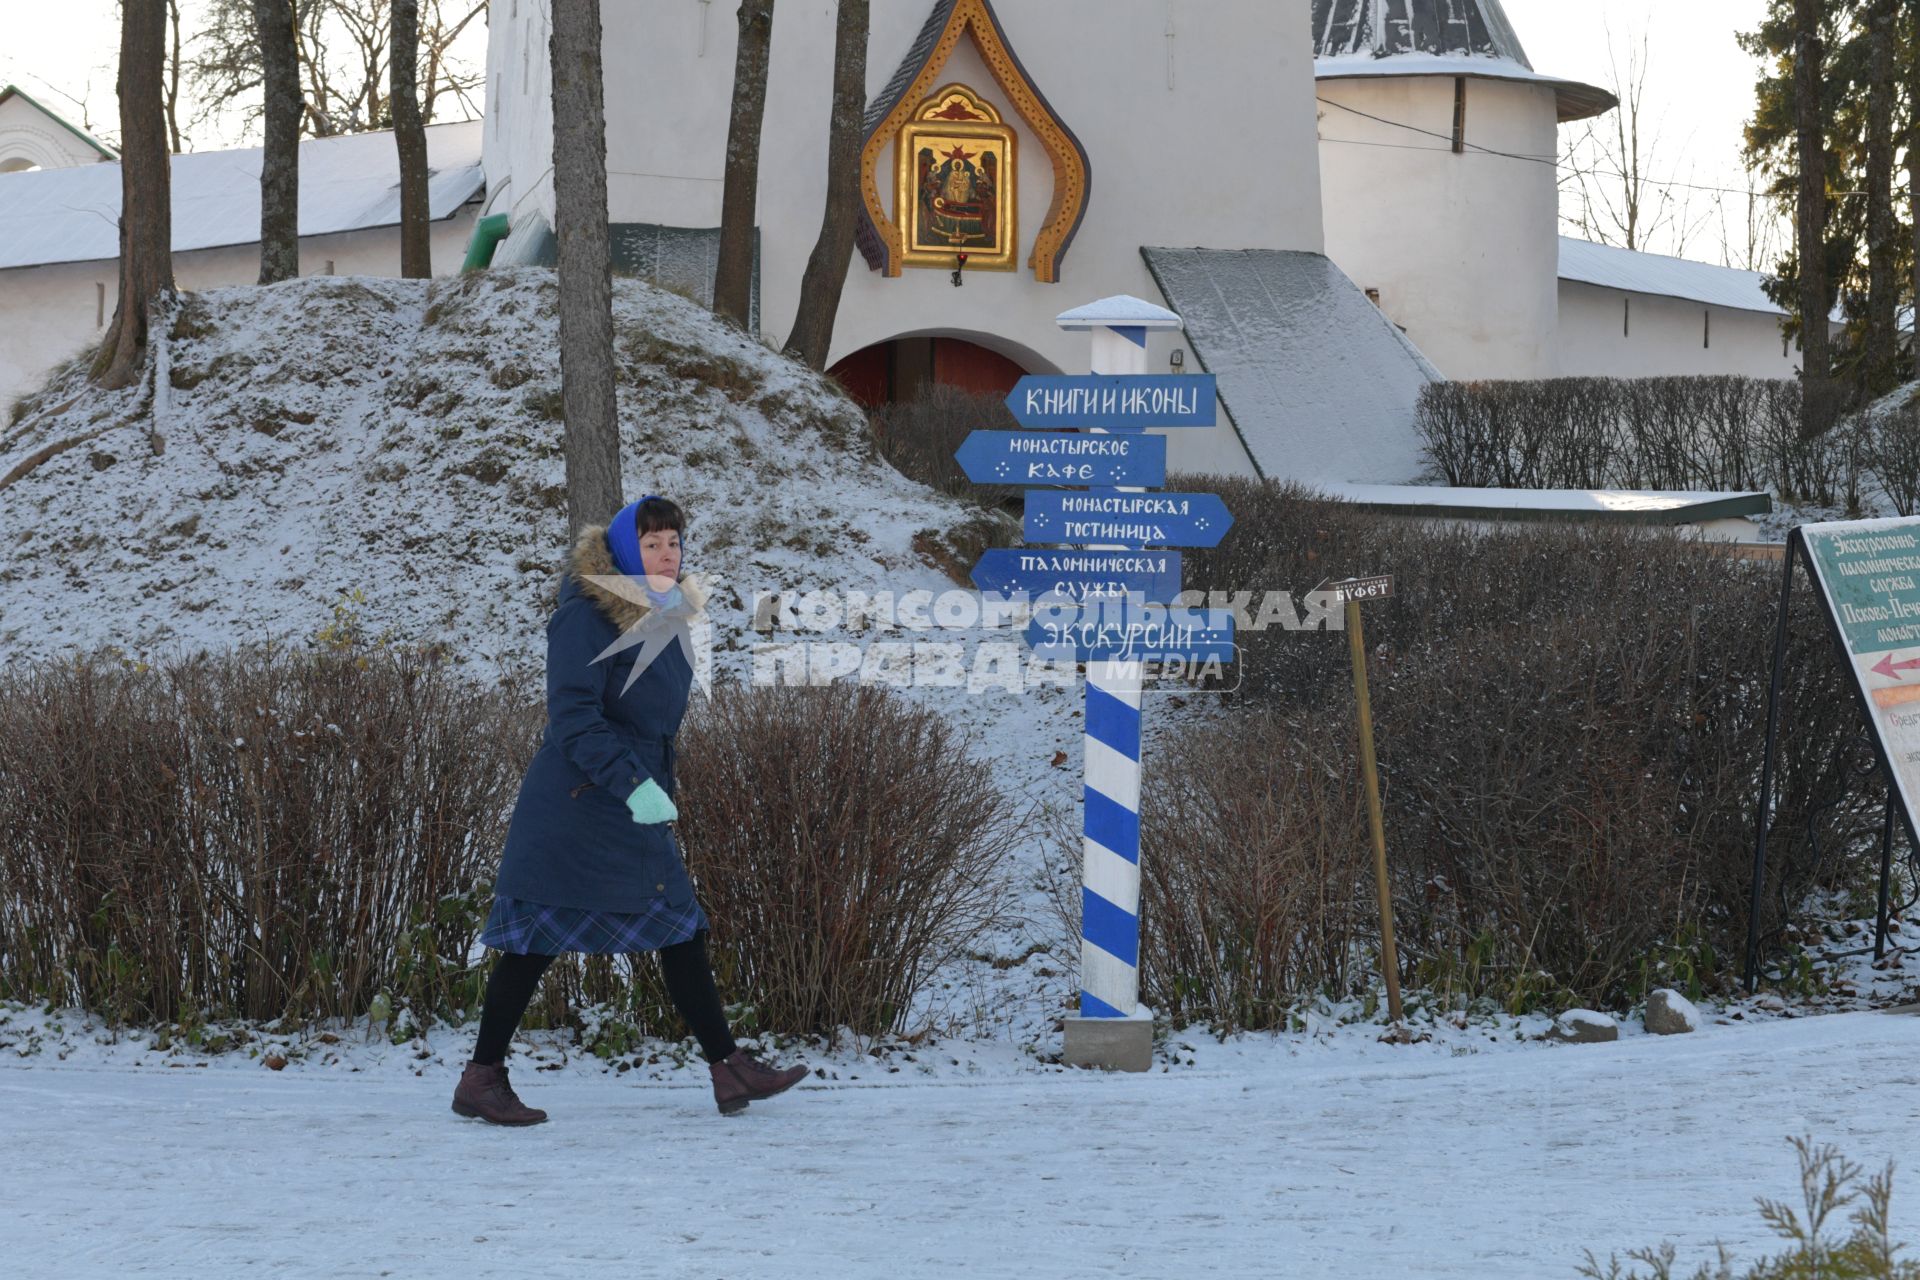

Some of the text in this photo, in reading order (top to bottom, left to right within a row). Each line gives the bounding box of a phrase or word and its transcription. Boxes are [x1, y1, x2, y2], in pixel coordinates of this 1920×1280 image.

[1026, 387, 1198, 415] КНИГИ И ИКОНЫ
[1010, 438, 1129, 456] МОНАСТЫРСКОЕ
[1028, 463, 1096, 480] КАФЕ
[1062, 498, 1189, 516] МОНАСТЫРСКАЯ
[1064, 521, 1166, 545] ГОСТИНИЦА
[1020, 556, 1167, 573] ПАЛОМНИЧЕСКАЯ
[1054, 581, 1129, 601] СЛУЖБА
[1043, 621, 1193, 660] ЭКСКУРСИИ
